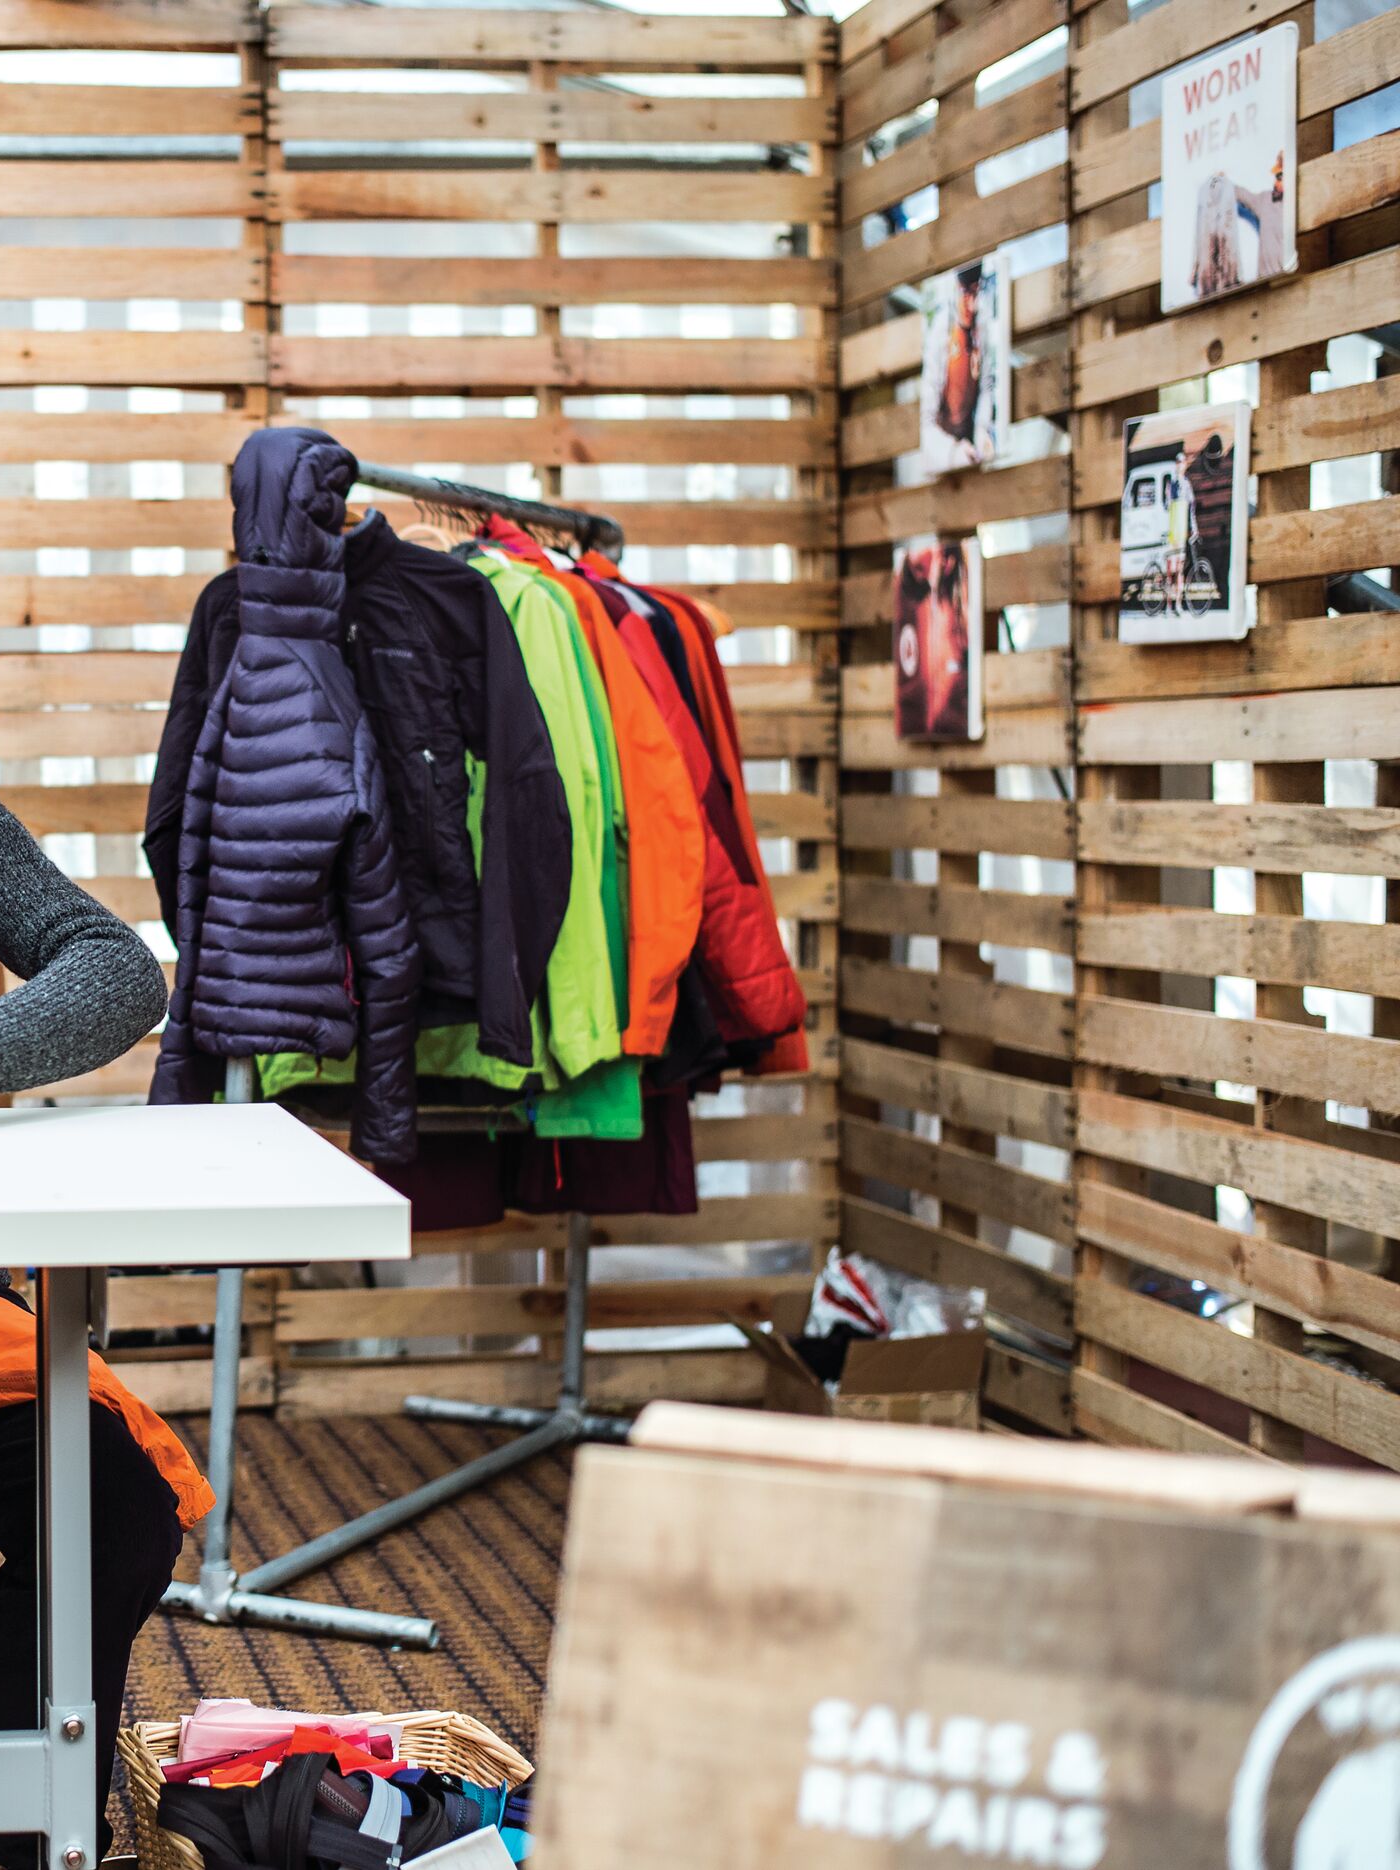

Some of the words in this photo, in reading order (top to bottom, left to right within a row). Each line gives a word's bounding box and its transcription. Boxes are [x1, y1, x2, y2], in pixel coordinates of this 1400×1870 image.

[1183, 47, 1261, 115] WORN
[1184, 102, 1258, 161] WEAR
[809, 1697, 1031, 1789] SALES
[1046, 1729, 1108, 1798] &
[798, 1764, 1108, 1870] REPAIRS
